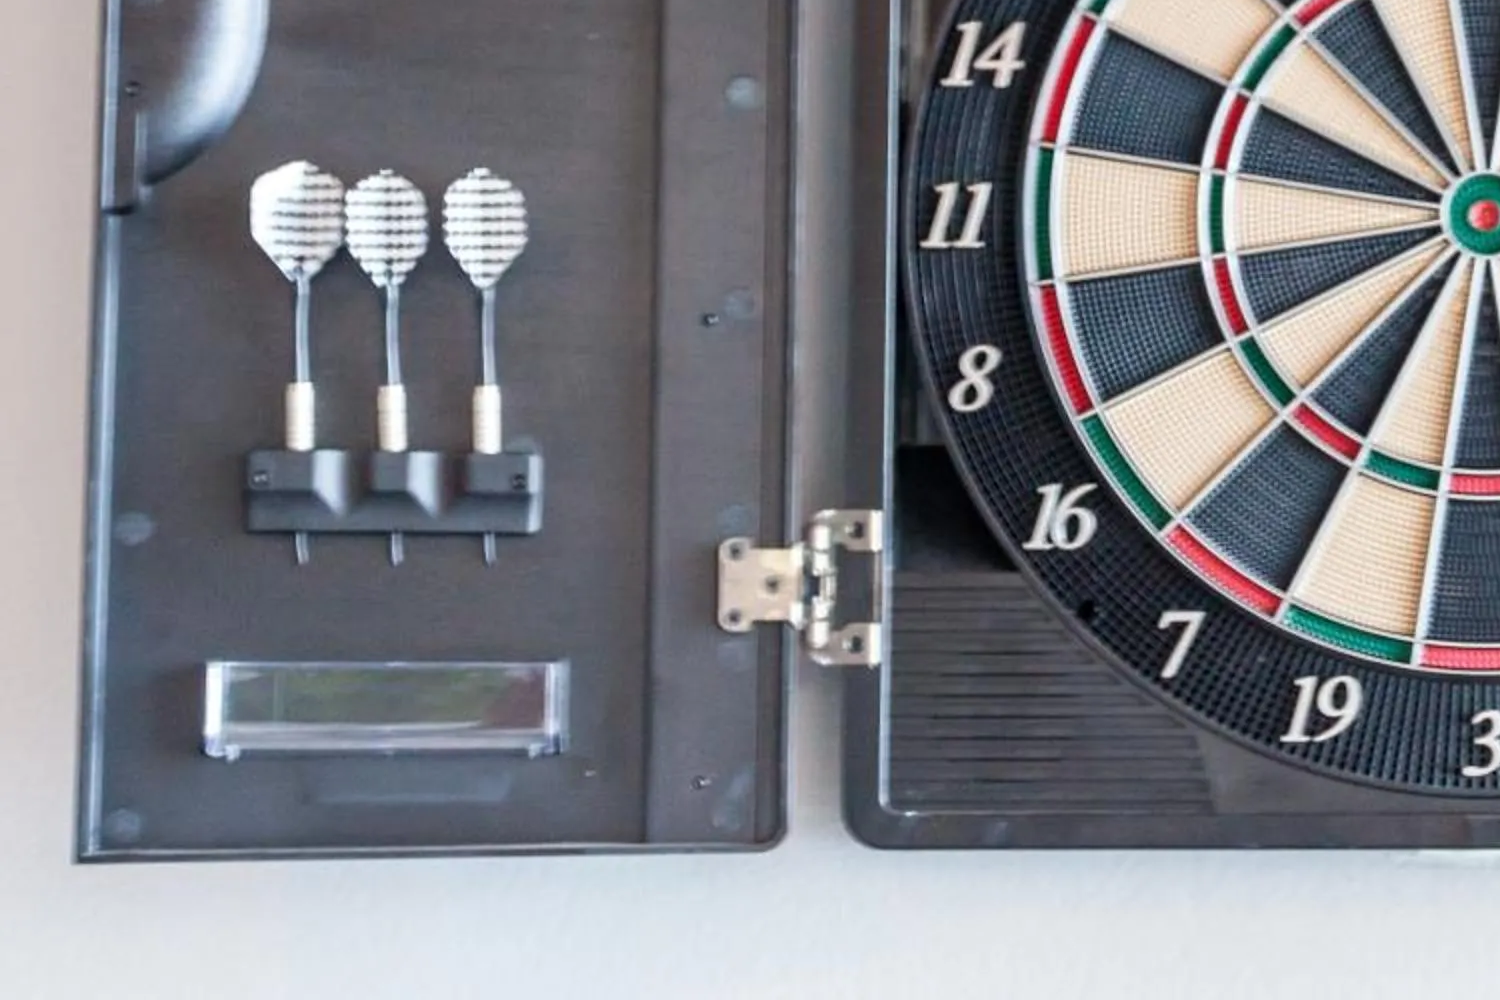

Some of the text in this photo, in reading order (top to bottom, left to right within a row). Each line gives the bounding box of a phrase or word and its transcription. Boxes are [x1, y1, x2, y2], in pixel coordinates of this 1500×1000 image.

[940, 20, 1026, 89] 14
[919, 181, 993, 249] 11
[948, 344, 1002, 412] 8
[1022, 483, 1098, 551] 16
[1157, 610, 1206, 679] 7
[1279, 674, 1364, 743] 19
